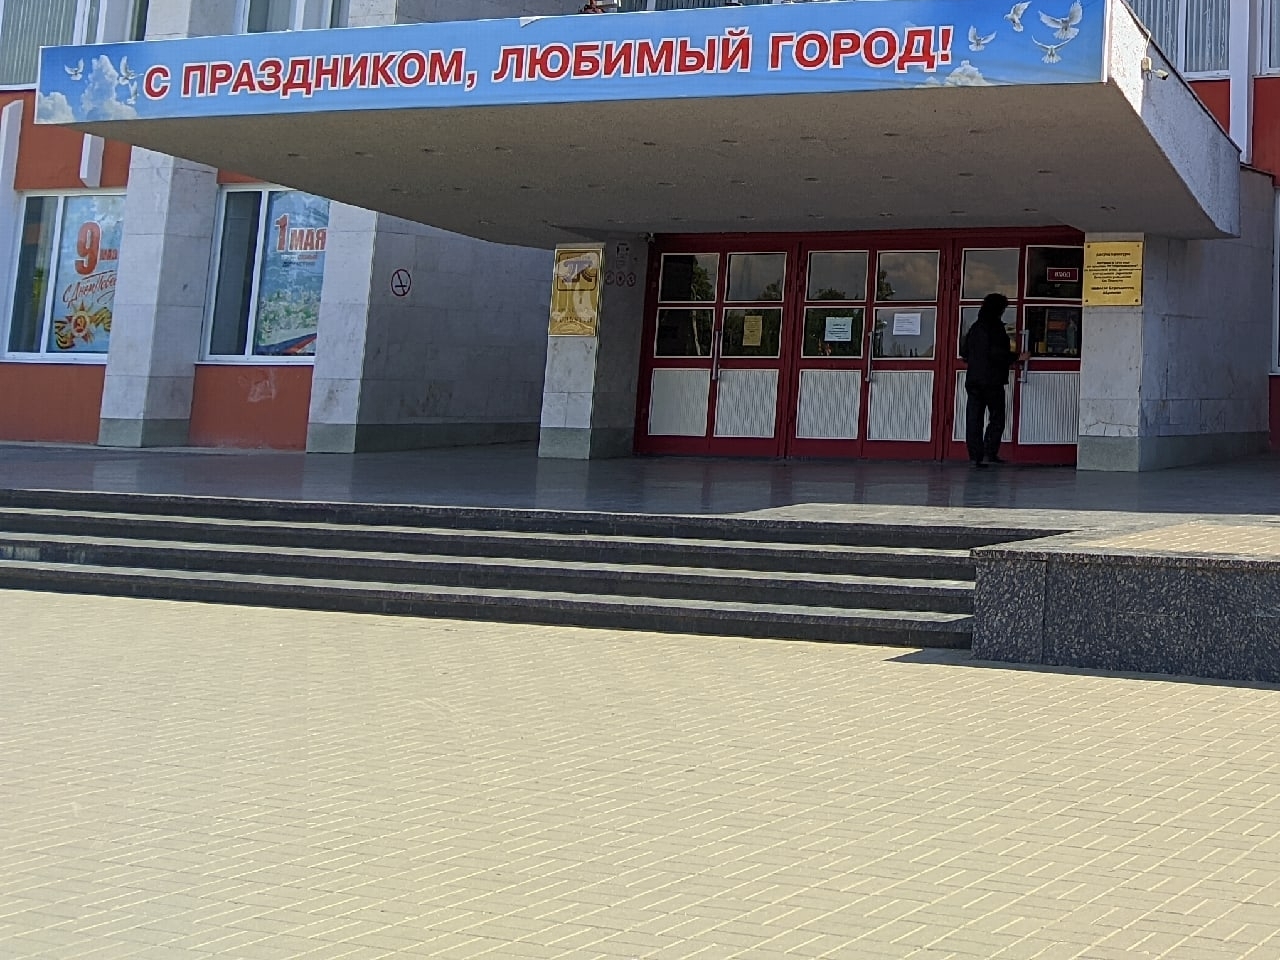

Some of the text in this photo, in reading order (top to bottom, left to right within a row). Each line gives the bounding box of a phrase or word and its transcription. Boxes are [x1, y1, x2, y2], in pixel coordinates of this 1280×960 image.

[144, 25, 954, 101] С ПРАЗДНИКОМ, ЛЮБИМЫЙ ГОРОД!
[75, 221, 102, 276] 9
[275, 213, 327, 252] 1 МАЯ
